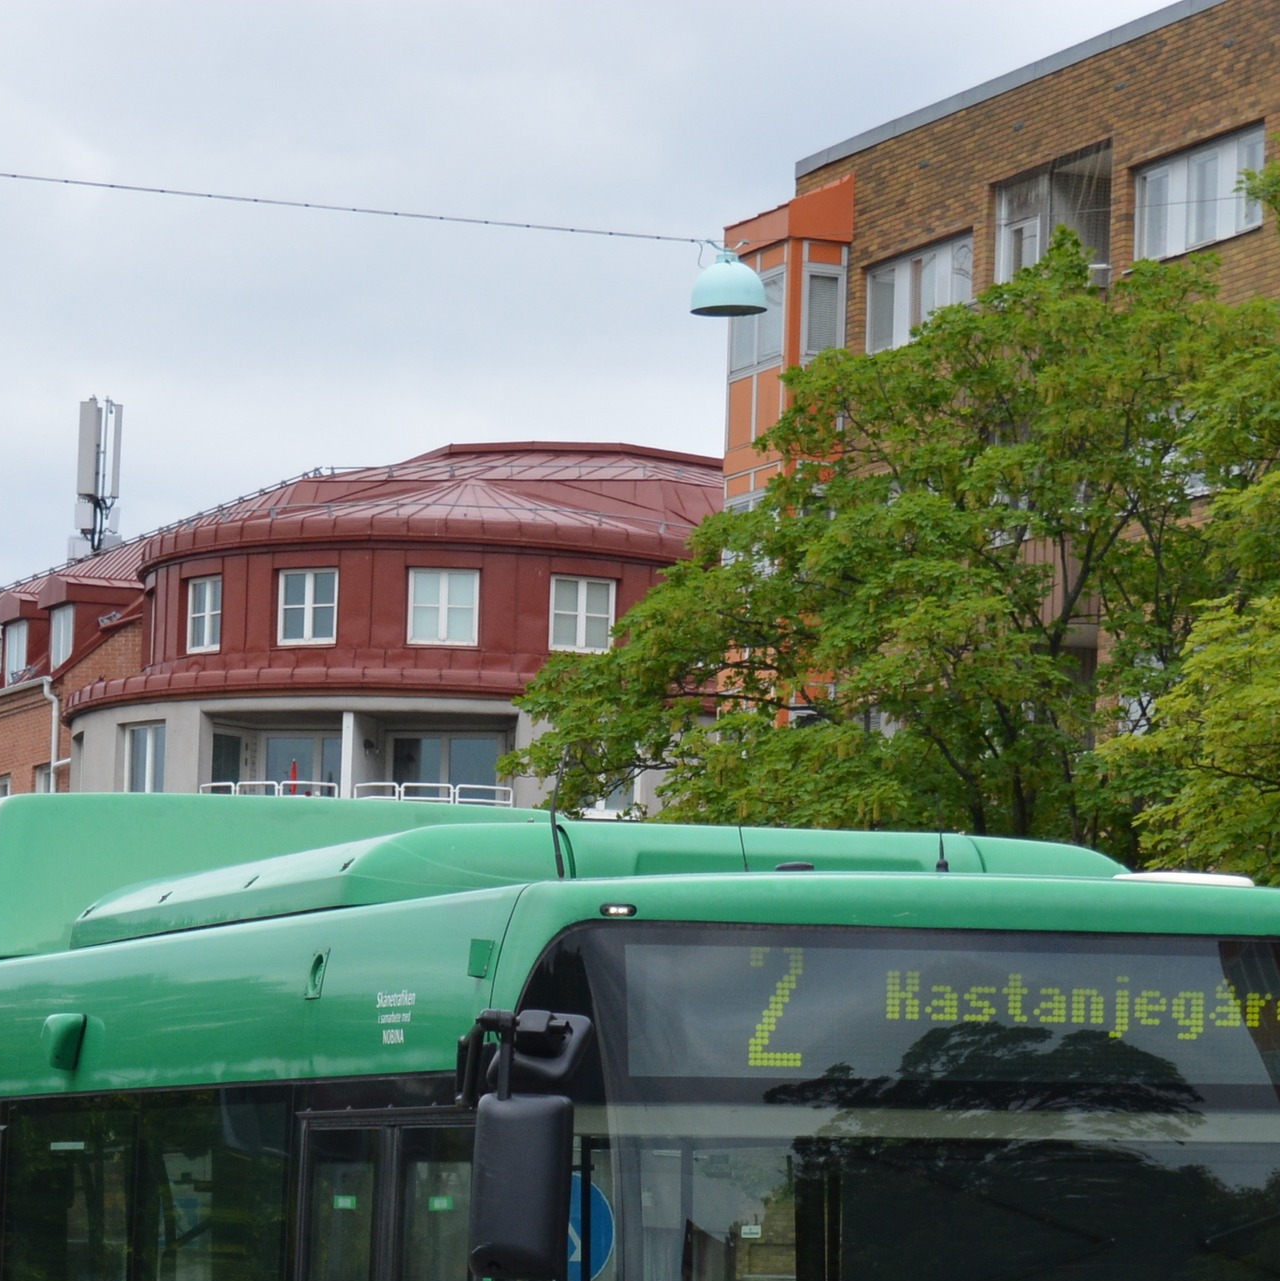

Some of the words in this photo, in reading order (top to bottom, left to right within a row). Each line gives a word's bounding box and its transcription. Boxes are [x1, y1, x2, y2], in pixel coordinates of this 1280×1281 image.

[376, 989, 416, 1008] Skånetrafiken
[747, 946, 804, 1067] 2
[382, 1029, 404, 1044] NOBINA
